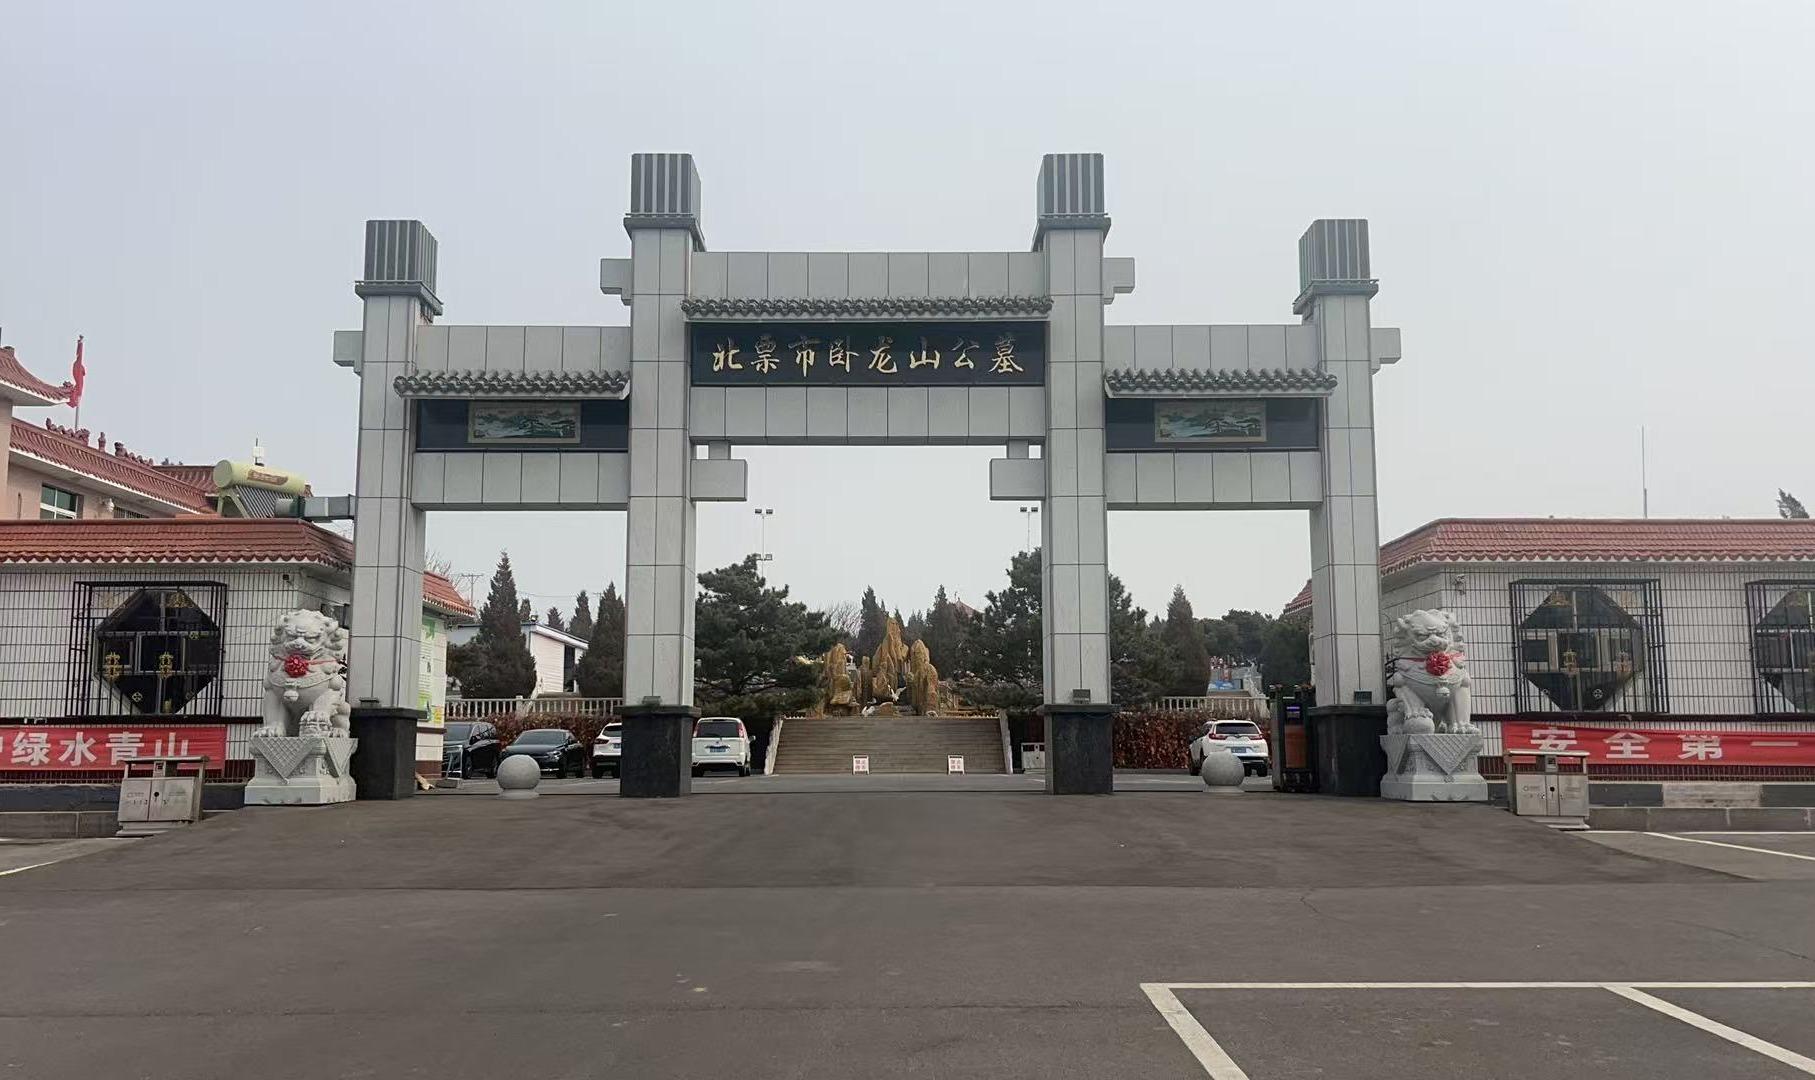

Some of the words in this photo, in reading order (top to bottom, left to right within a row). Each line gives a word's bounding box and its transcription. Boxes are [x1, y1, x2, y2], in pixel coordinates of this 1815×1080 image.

[711, 334, 1025, 377] 北票市卧龙山公墓
[0, 731, 190, 767] 绿水青山
[1530, 727, 1799, 760] 安全第一
